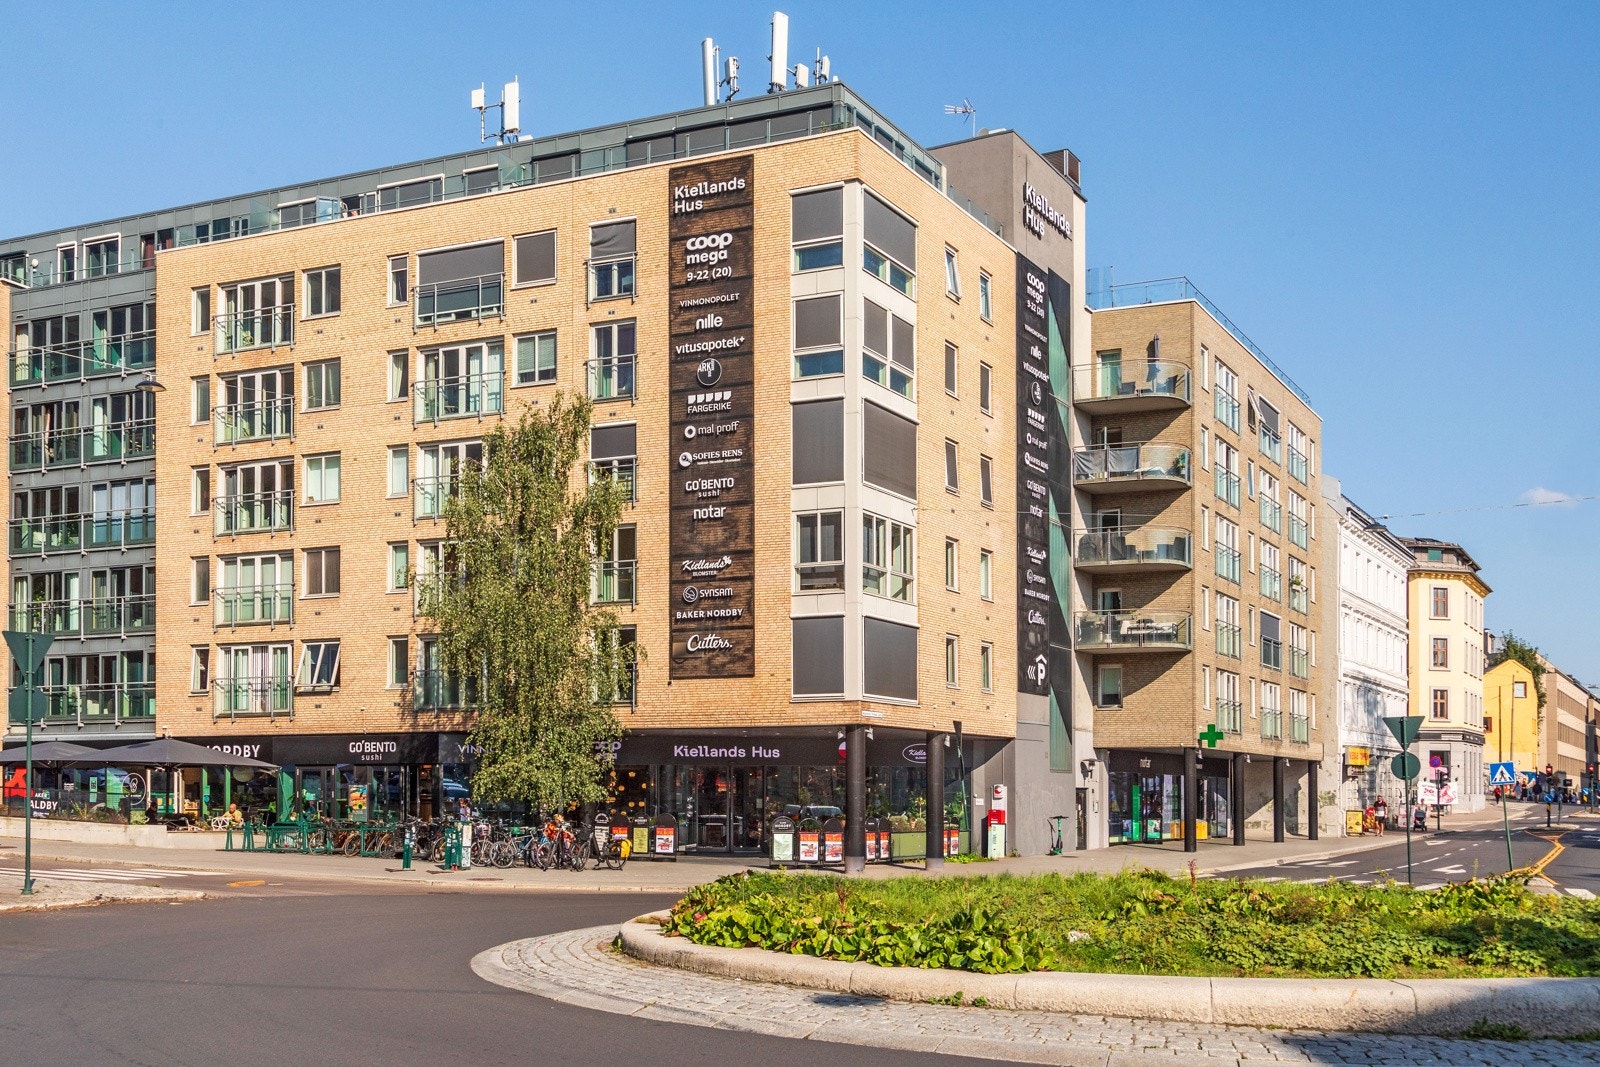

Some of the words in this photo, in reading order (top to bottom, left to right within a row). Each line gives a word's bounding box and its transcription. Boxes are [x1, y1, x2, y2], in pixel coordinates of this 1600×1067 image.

[674, 177, 746, 199] Kiellands
[674, 200, 703, 214] Hus
[1025, 181, 1070, 235] Kiellands
[1025, 204, 1045, 236] Hus
[686, 232, 733, 251] coop
[686, 250, 728, 266] mega
[687, 270, 709, 282] 9-22
[712, 265, 732, 279] (20)
[1026, 272, 1045, 293] coop
[679, 293, 740, 307] VINMONOPOLET
[1026, 285, 1044, 304] mega
[695, 314, 724, 330] nille
[687, 401, 732, 414] FARGERIKE
[698, 423, 715, 434] mal
[716, 420, 740, 435] proff
[692, 450, 721, 461] SOFIES
[721, 448, 743, 458] RENS
[698, 489, 721, 498] sushi
[693, 506, 726, 520] notar
[682, 557, 728, 571] Kiellands
[676, 610, 705, 619] BAKER
[706, 608, 743, 618] NORDBY
[1037, 662, 1046, 686] P
[206, 744, 260, 758] RDBY
[361, 753, 383, 761] sushi
[673, 745, 746, 758] Kiellands
[751, 746, 781, 758] Hus
